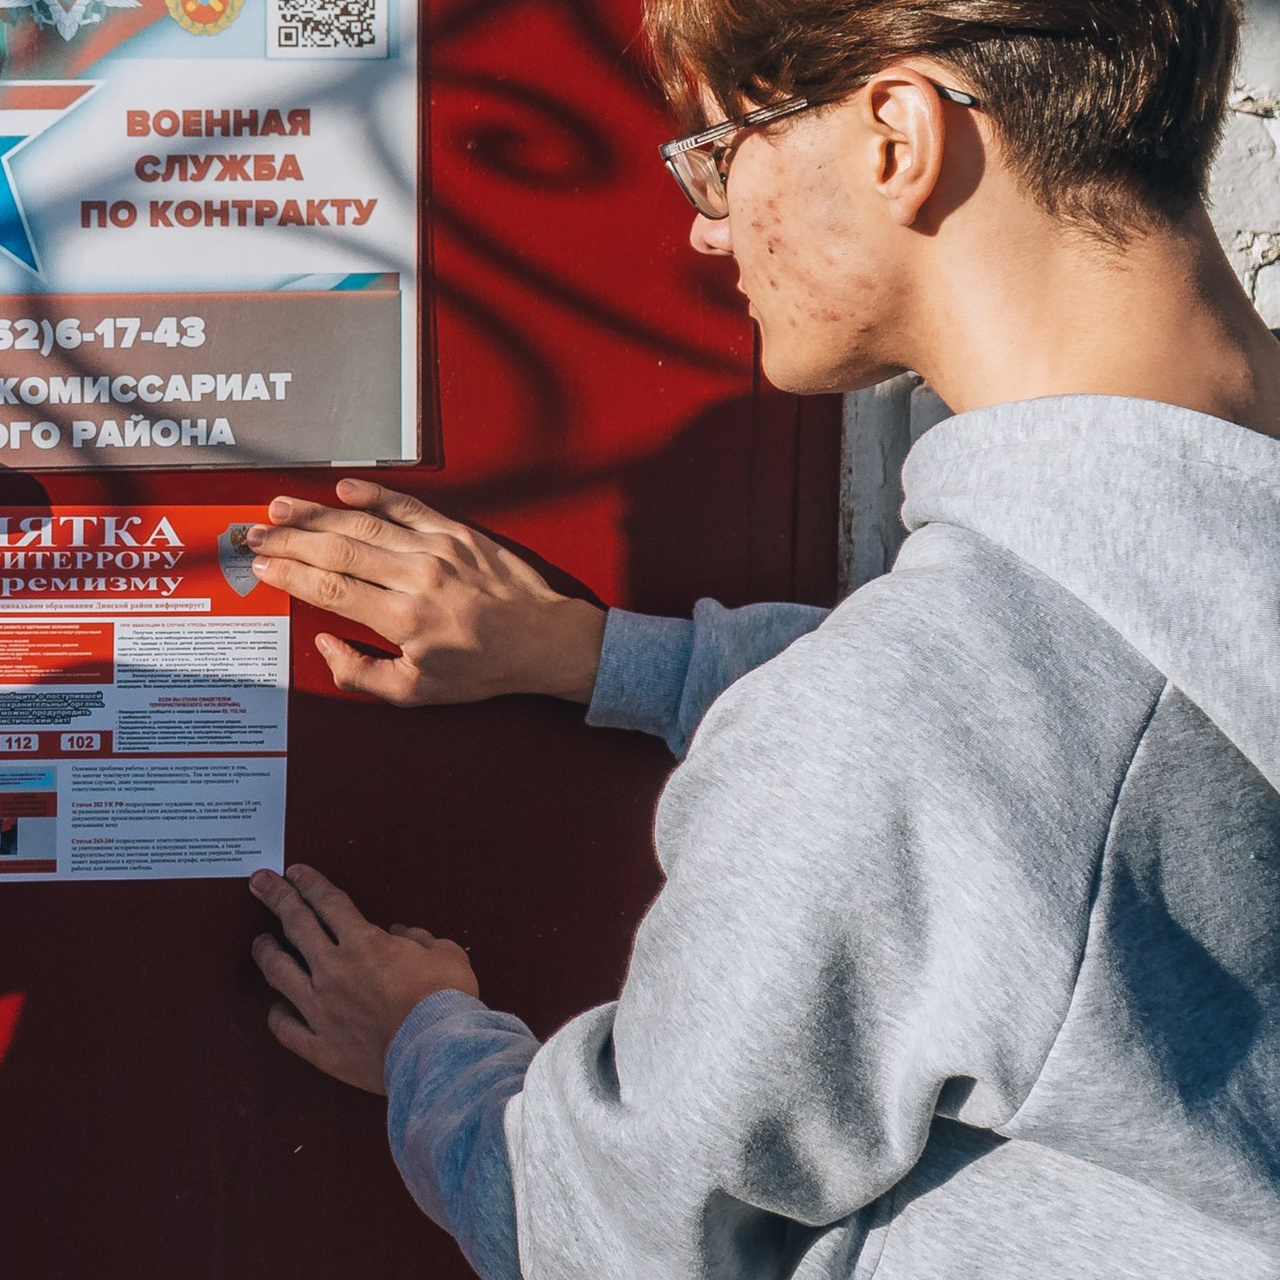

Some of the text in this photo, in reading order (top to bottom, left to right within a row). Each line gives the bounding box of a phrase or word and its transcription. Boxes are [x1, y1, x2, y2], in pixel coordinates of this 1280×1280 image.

[126, 109, 311, 138] ВОЕННАЯ
[134, 154, 304, 183] СЛУЖБА
[80, 198, 379, 228] ПО КОНТРАКТУ
[73, 413, 237, 449] РАЙОНА
[5, 737, 32, 750] 112
[67, 736, 94, 749] 102
